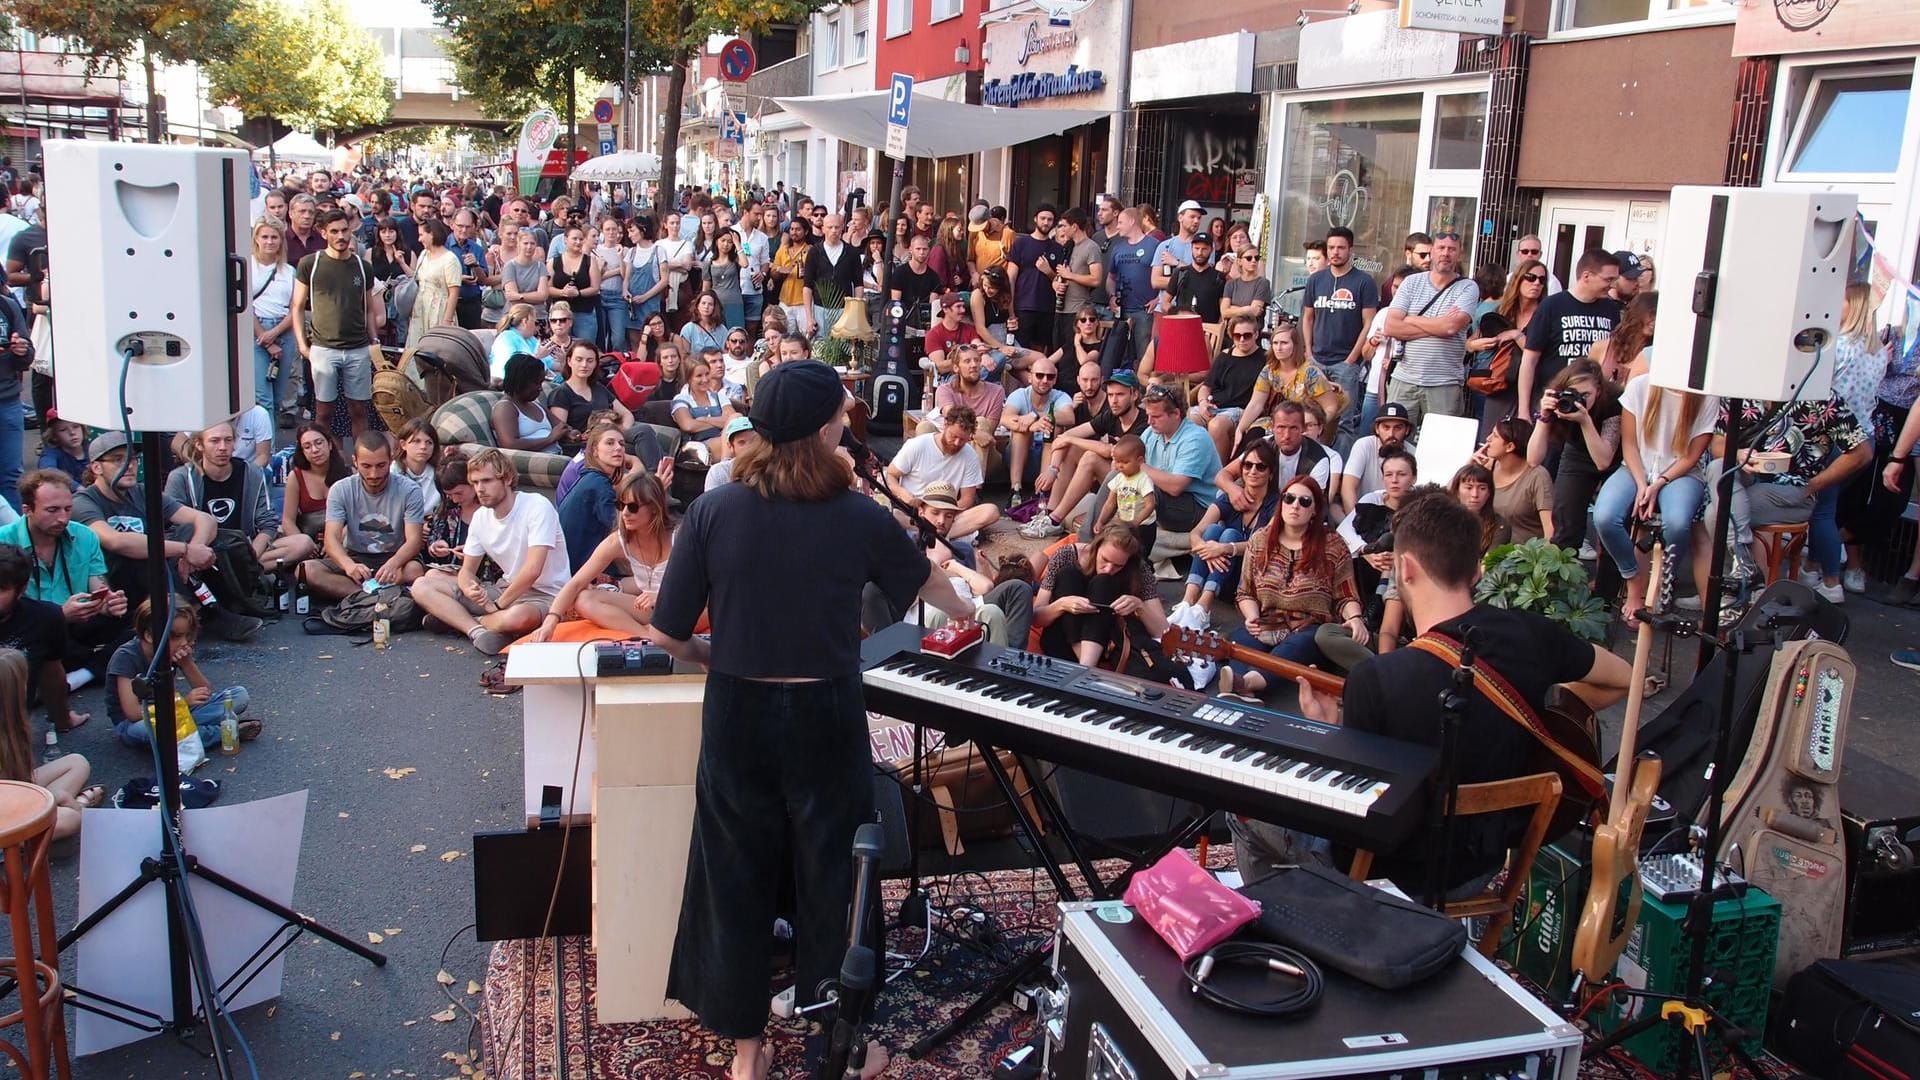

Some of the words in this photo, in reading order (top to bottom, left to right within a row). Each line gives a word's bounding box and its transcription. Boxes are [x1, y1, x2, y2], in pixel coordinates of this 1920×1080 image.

[1039, 65, 1099, 98] Brauhaus
[891, 80, 907, 118] P
[603, 142, 611, 155] P
[1561, 315, 1595, 329] SURELY
[1596, 316, 1612, 331] NOT
[1562, 328, 1611, 343] EVERYBOD
[1558, 343, 1580, 357] WAS
[1798, 857, 1826, 874] STORE
[1537, 888, 1557, 954] Gilden
[1551, 912, 1562, 945] Kölsch
